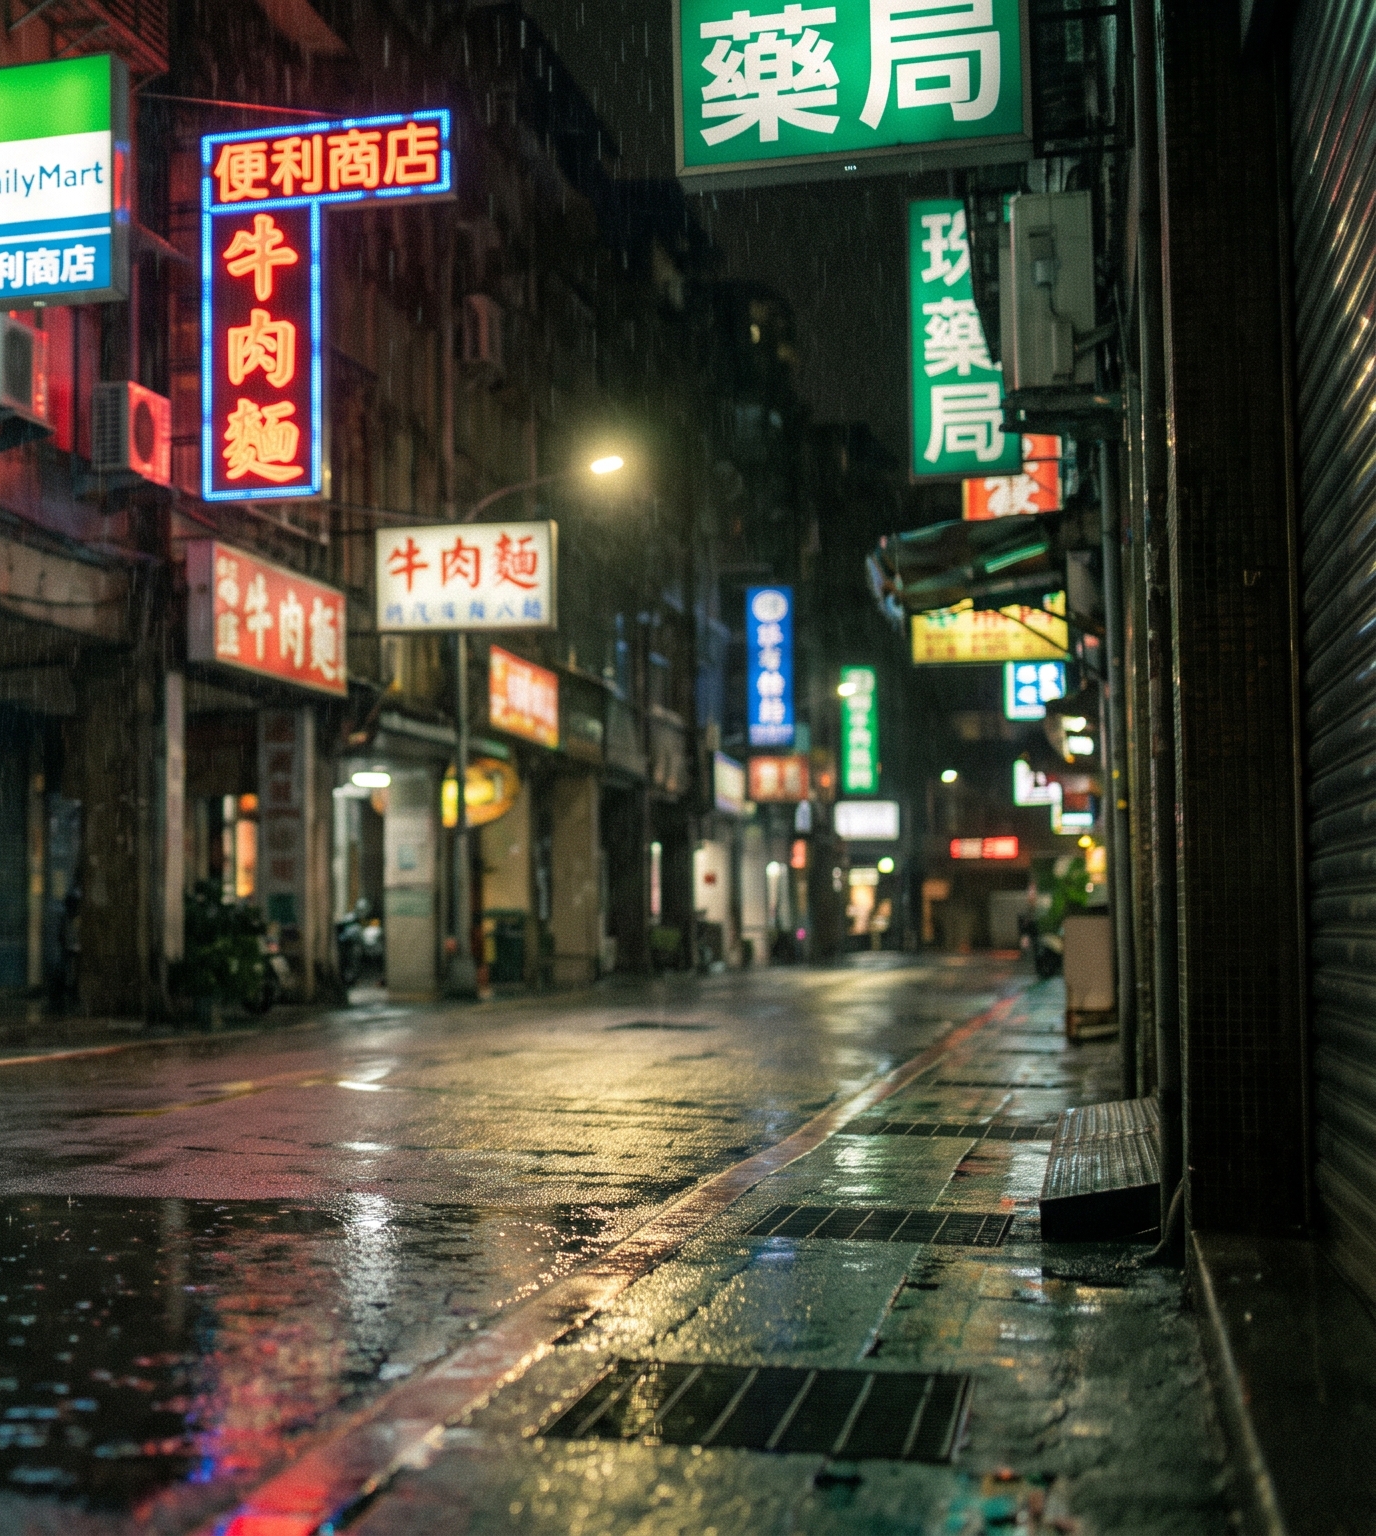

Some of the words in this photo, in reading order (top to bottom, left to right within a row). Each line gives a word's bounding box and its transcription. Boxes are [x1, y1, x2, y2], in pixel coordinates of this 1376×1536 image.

[700, 0, 1001, 146] 藥局
[214, 122, 439, 203] 便利商店
[222, 213, 304, 483] 牛肉麵
[387, 531, 541, 594] 牛肉麵
